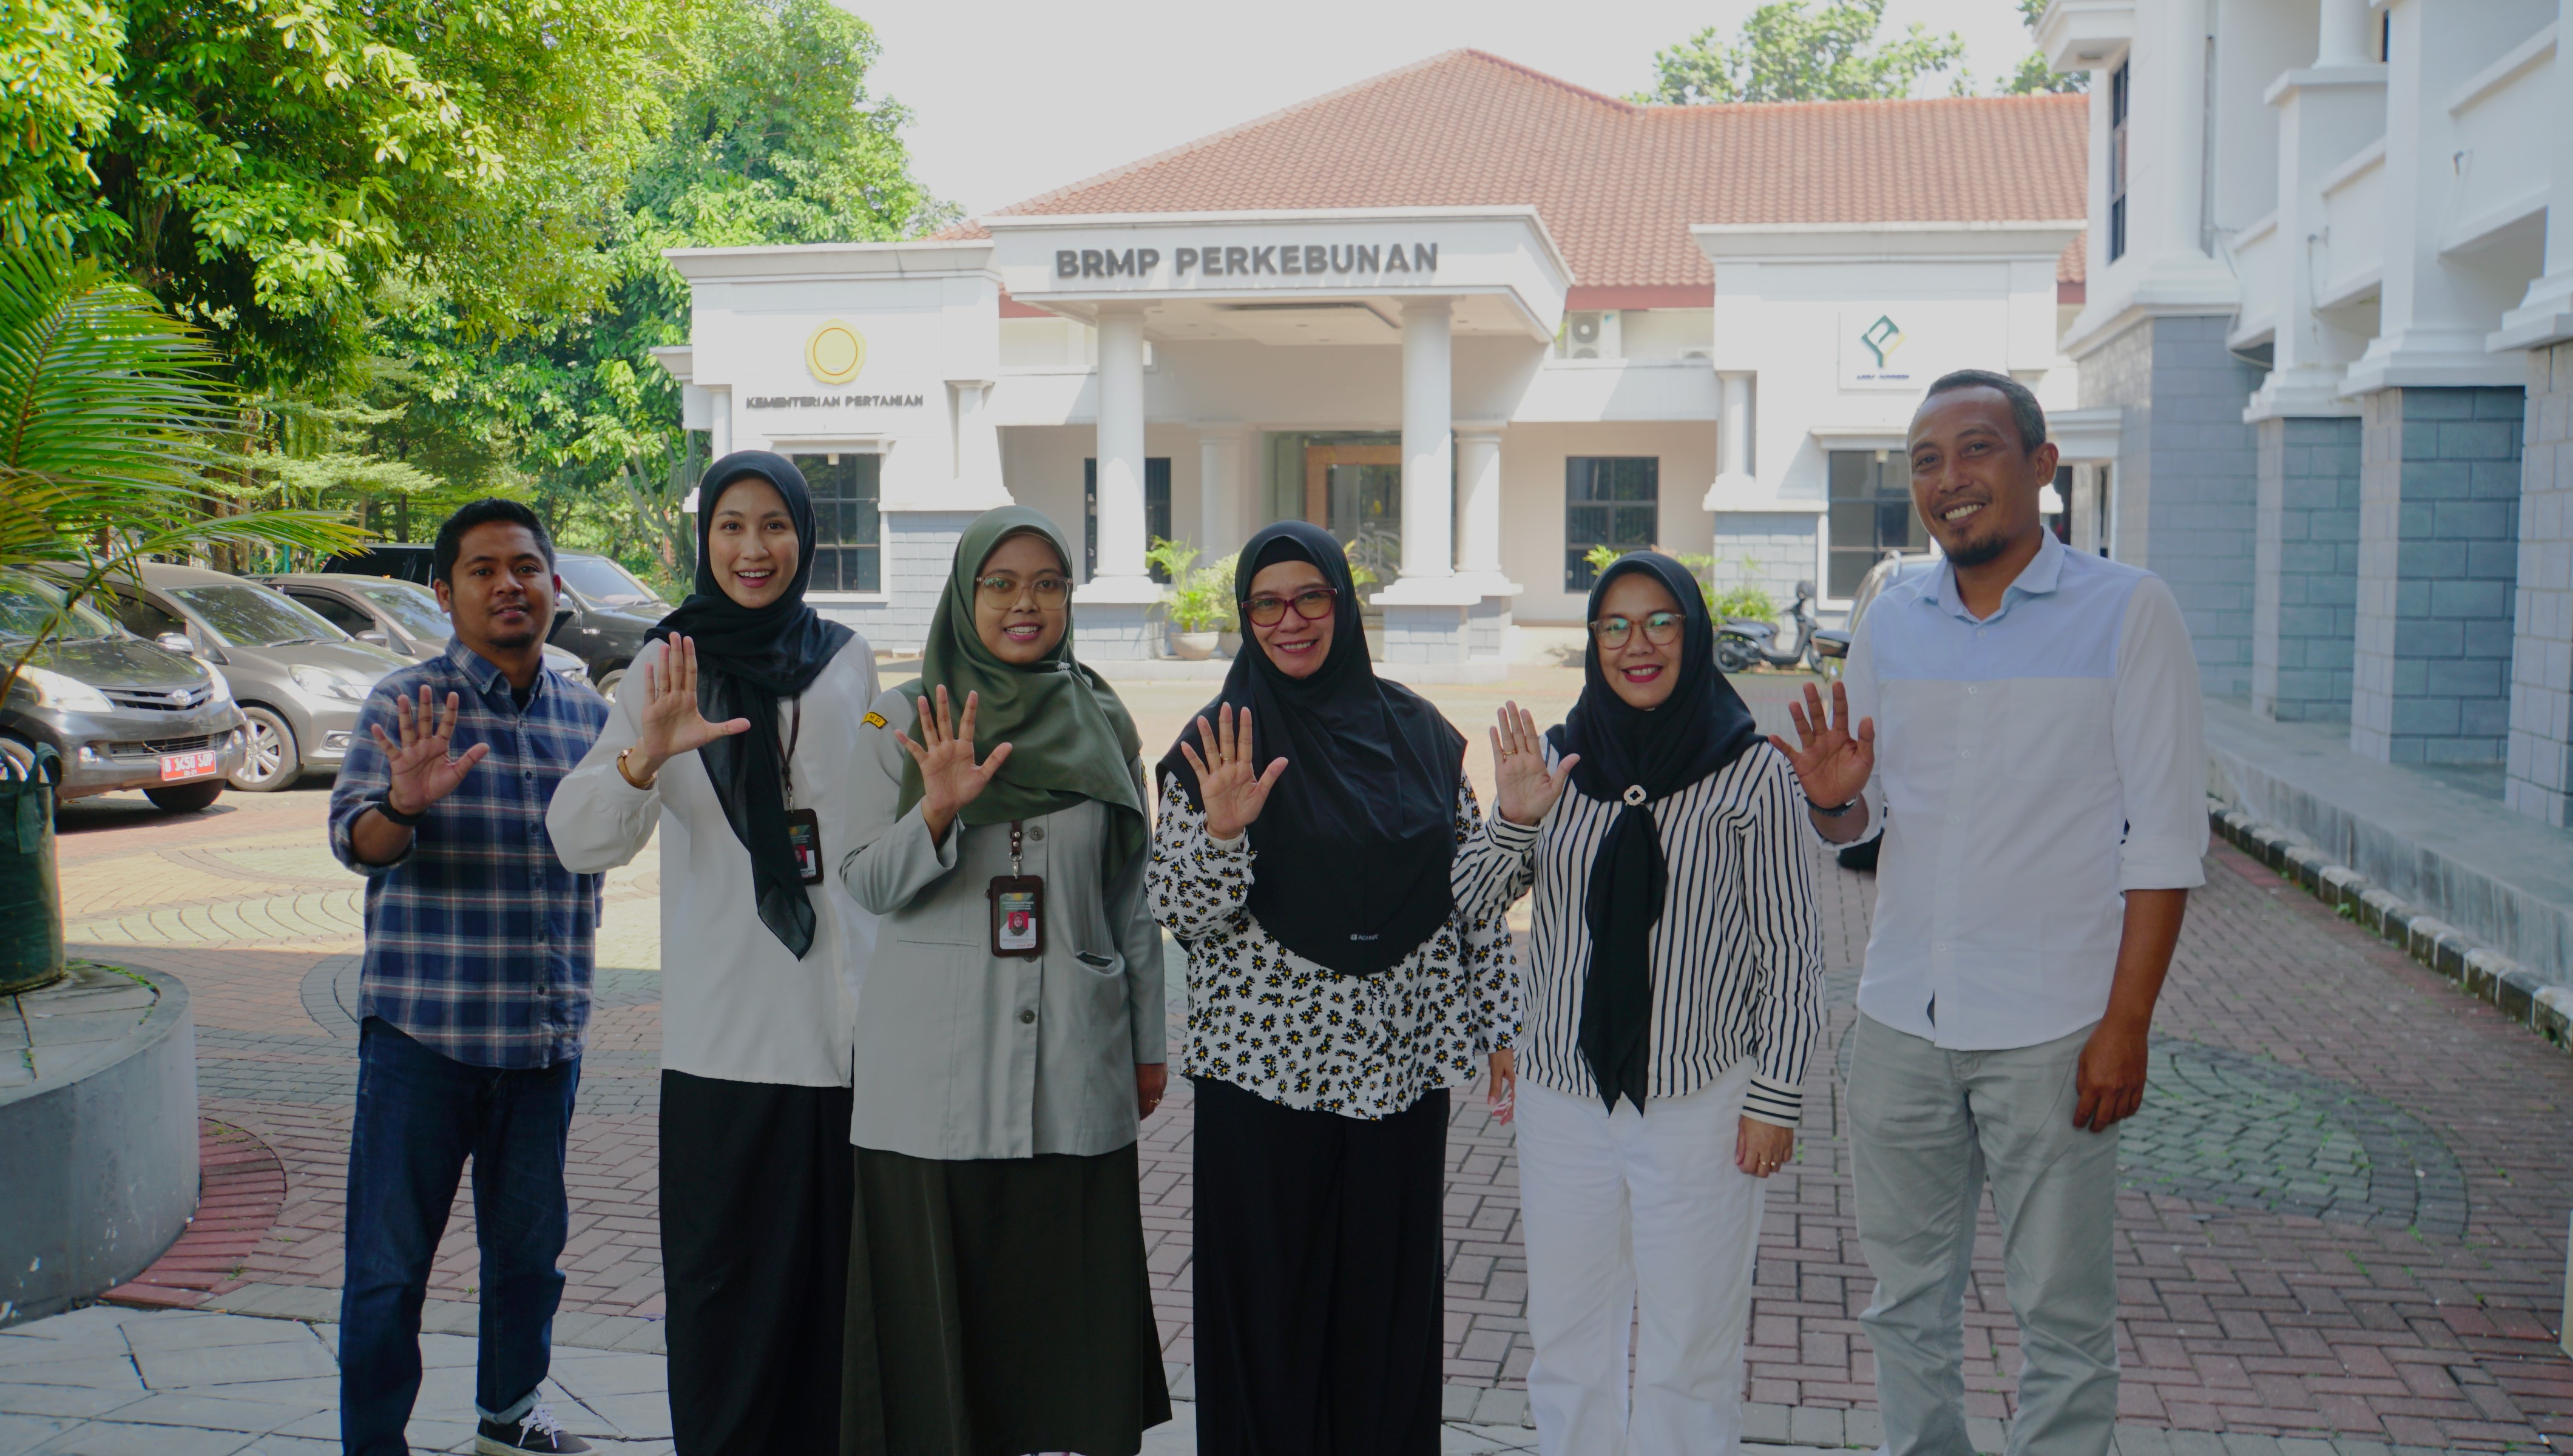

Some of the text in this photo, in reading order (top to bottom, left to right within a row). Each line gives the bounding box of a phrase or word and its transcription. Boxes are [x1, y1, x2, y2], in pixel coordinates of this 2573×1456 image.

[1056, 243, 1438, 278] BRMP PERKEBUNAN
[746, 394, 923, 408] KEMENTERIAN PERTANIAN
[164, 758, 172, 773] B
